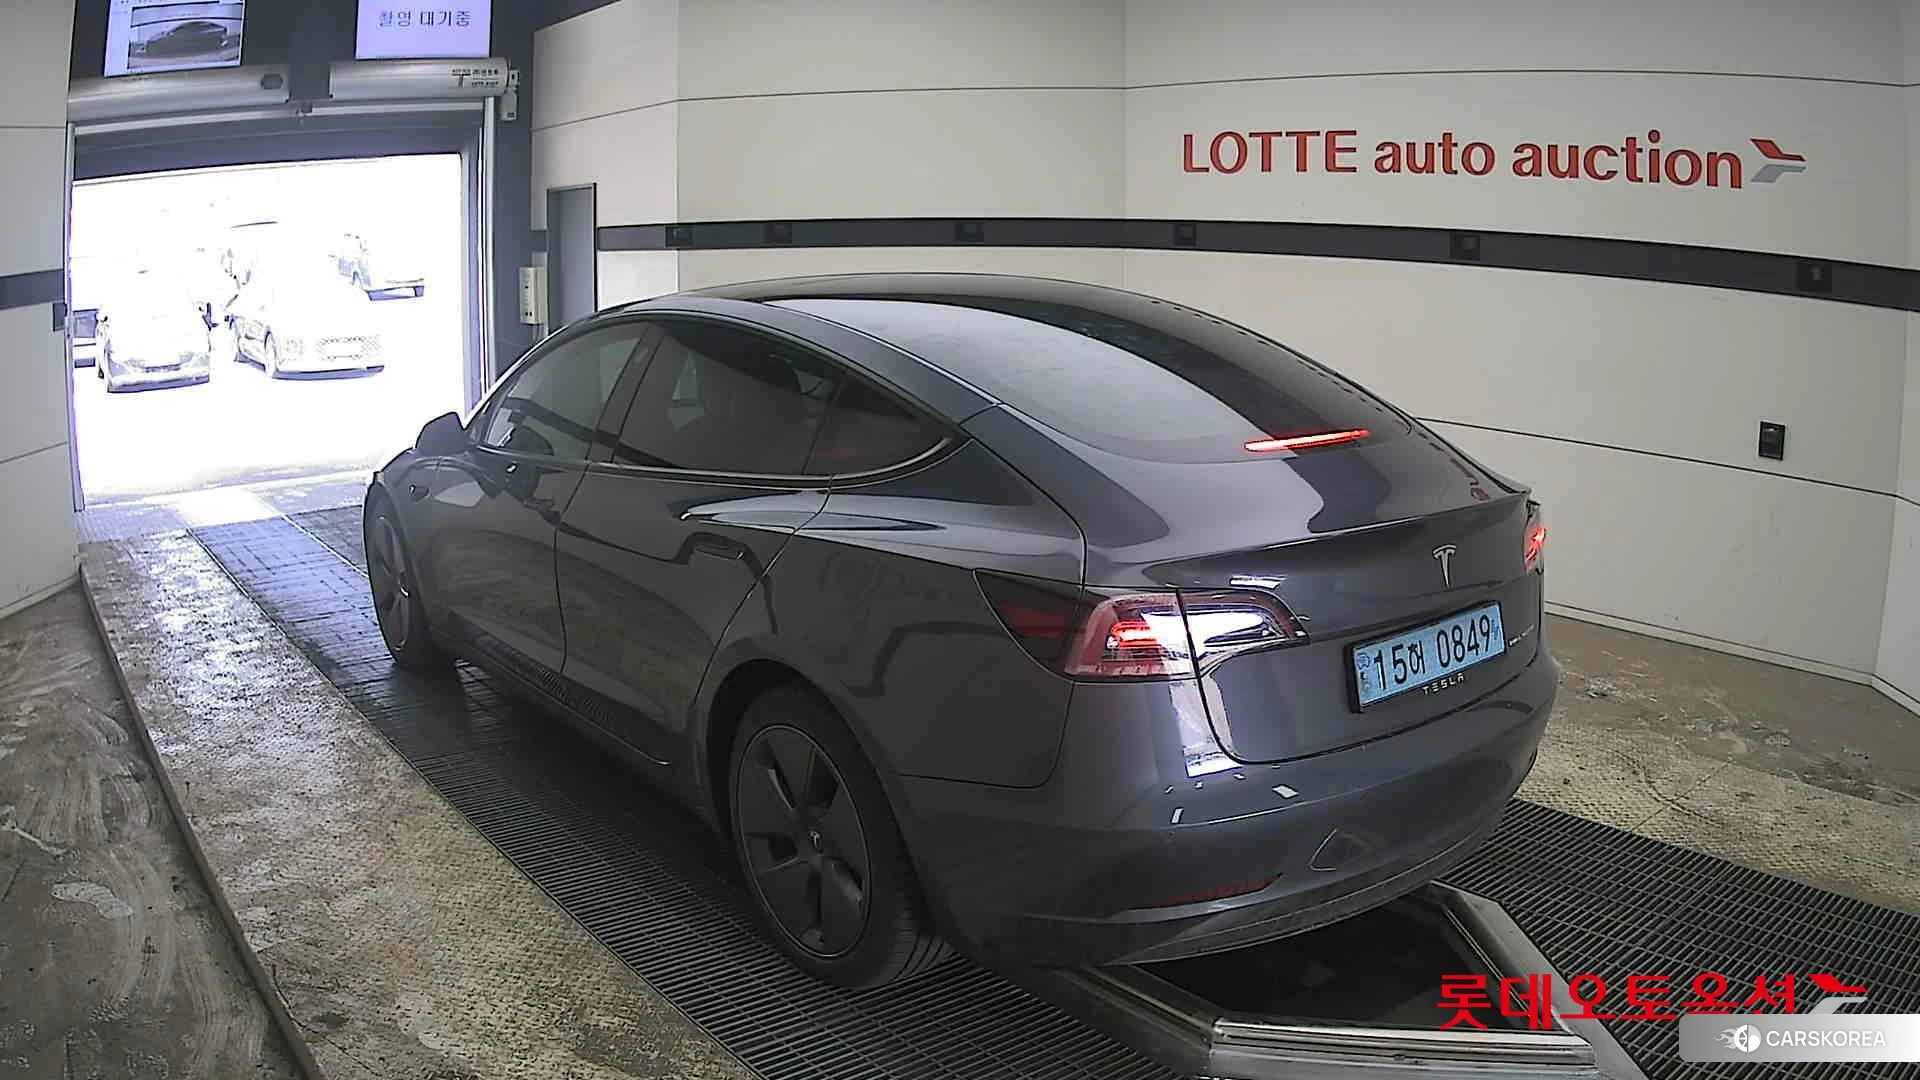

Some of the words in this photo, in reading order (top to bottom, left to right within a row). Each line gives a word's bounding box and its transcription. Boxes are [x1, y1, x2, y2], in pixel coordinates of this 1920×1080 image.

[420, 10, 472, 27] 대기중
[1183, 130, 1357, 174] LOTTE
[1374, 131, 1496, 177] auto
[1512, 129, 1743, 189] auction
[1373, 640, 1426, 690] 15허
[1436, 614, 1491, 668] 0849
[1422, 673, 1465, 696] TESLA
